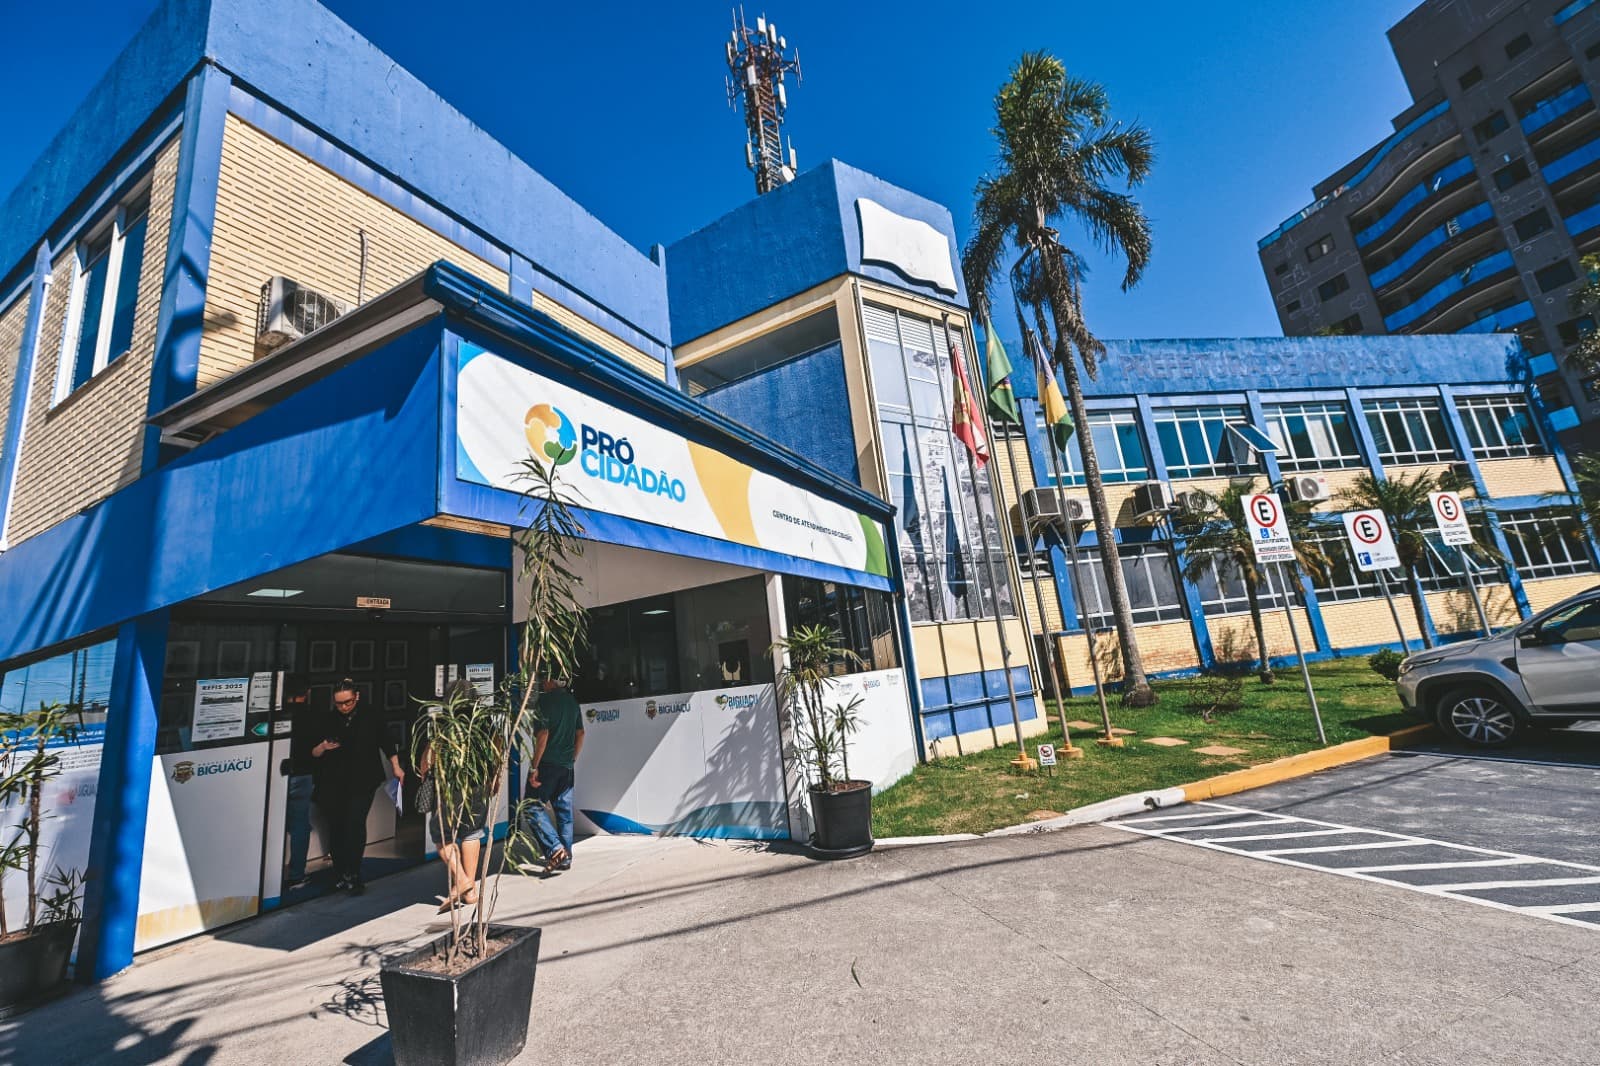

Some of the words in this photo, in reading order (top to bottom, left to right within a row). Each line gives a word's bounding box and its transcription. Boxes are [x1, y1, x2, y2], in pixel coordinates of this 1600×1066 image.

[581, 423, 635, 465] PRÓ
[580, 448, 685, 502] CIDADÃO
[1257, 501, 1270, 521] E
[1442, 500, 1453, 515] E
[772, 510, 793, 523] CENTRO
[793, 516, 801, 526] DE
[1360, 520, 1375, 538] E
[197, 760, 252, 776] BIGUAÇU
